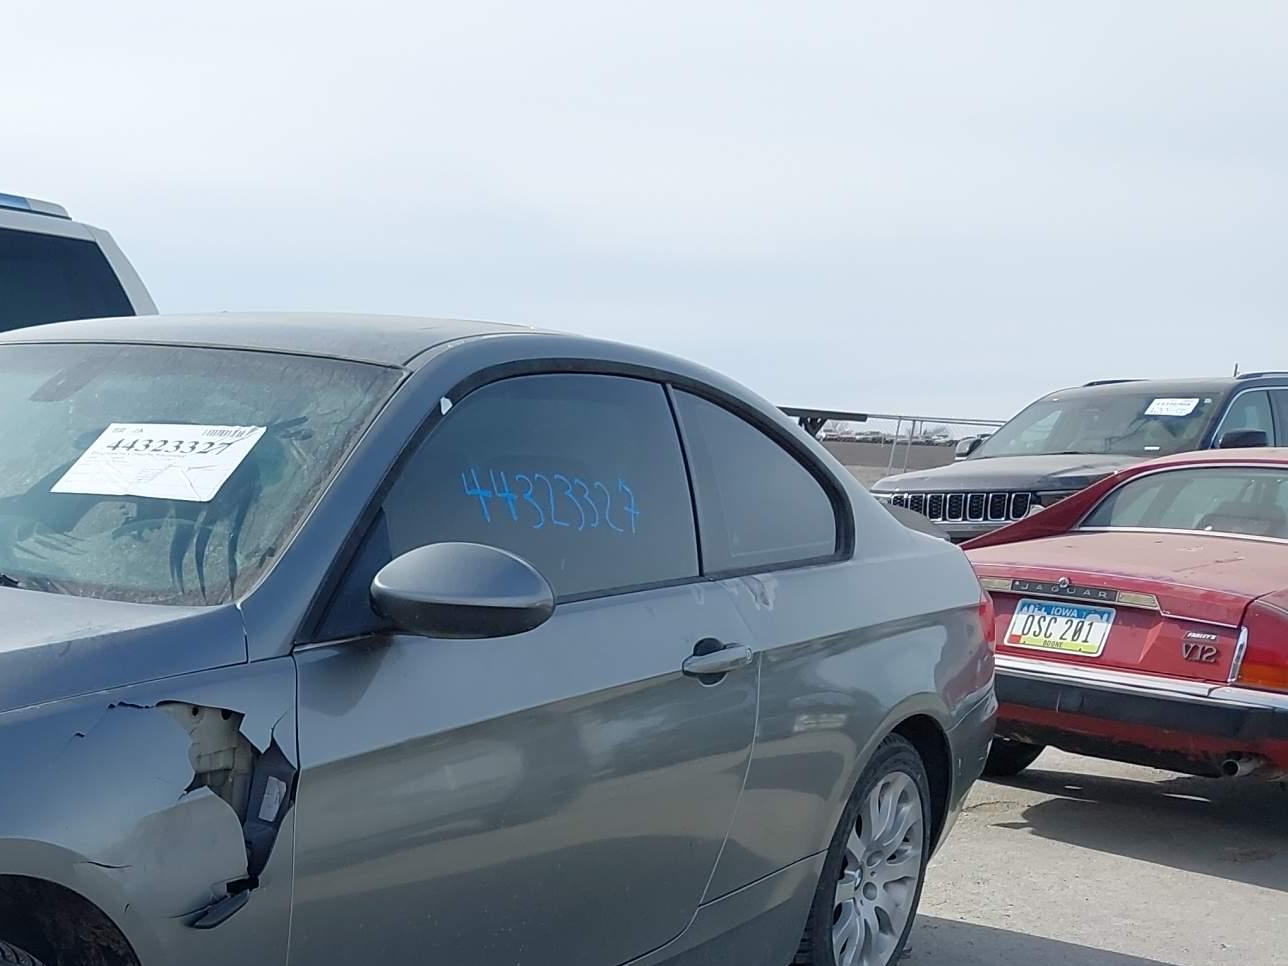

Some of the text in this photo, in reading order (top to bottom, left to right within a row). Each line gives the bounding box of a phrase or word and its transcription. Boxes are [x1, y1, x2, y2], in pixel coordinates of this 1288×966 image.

[106, 438, 233, 455] 44323327
[461, 466, 641, 536] 44323327
[1021, 583, 1108, 599] JAGUAR
[1051, 606, 1078, 618] IOWA
[1059, 618, 1094, 644] 201
[1183, 643, 1218, 663] V12
